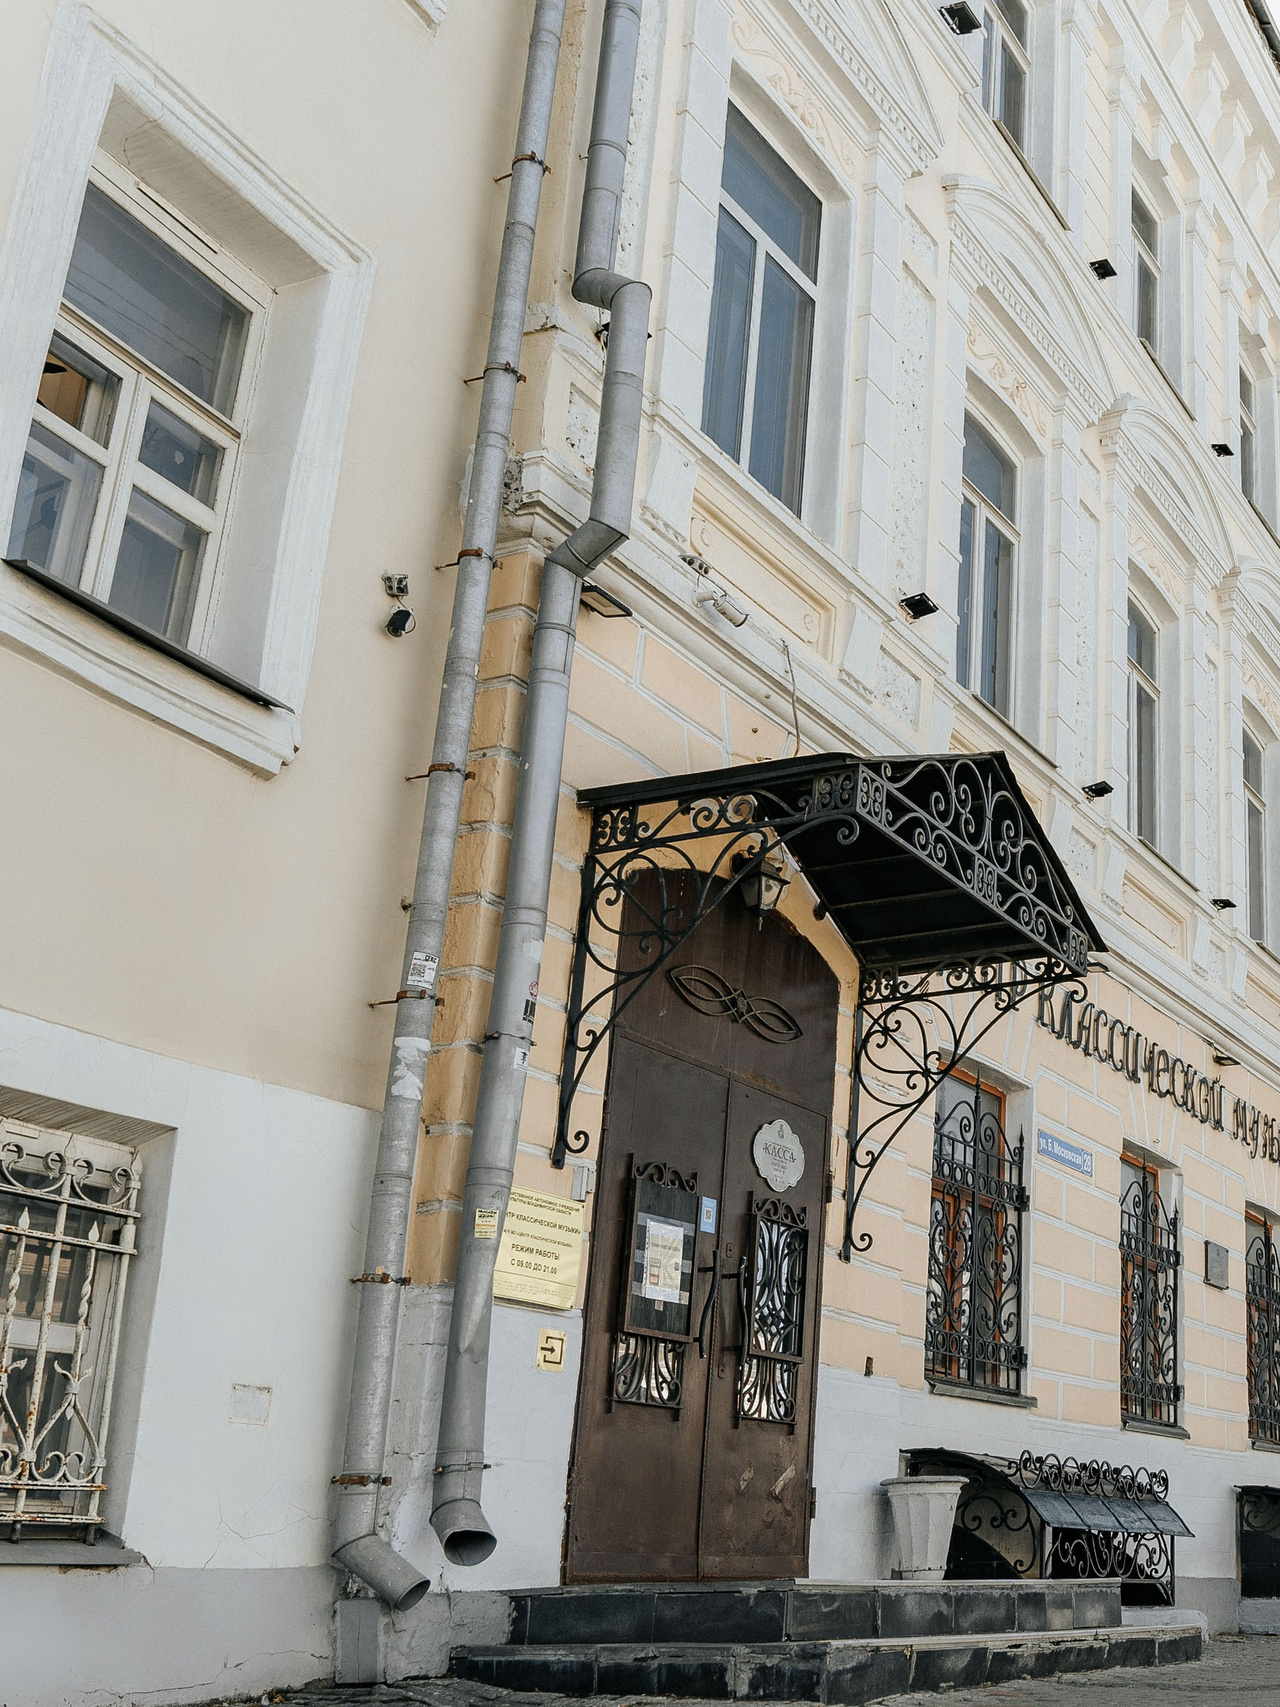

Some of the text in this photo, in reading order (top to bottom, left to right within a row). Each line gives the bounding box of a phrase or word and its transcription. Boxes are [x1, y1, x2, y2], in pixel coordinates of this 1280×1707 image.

[764, 1142, 796, 1163] КАССА
[1054, 1141, 1082, 1165] Московская
[1084, 1153, 1092, 1172] 28
[516, 1212, 557, 1229] КЛАССИЧЕСКОЙ
[511, 1243, 560, 1260] РЕЖИМ РАБОТЫ
[511, 1258, 558, 1275] С 09.00 ДО 21.00
